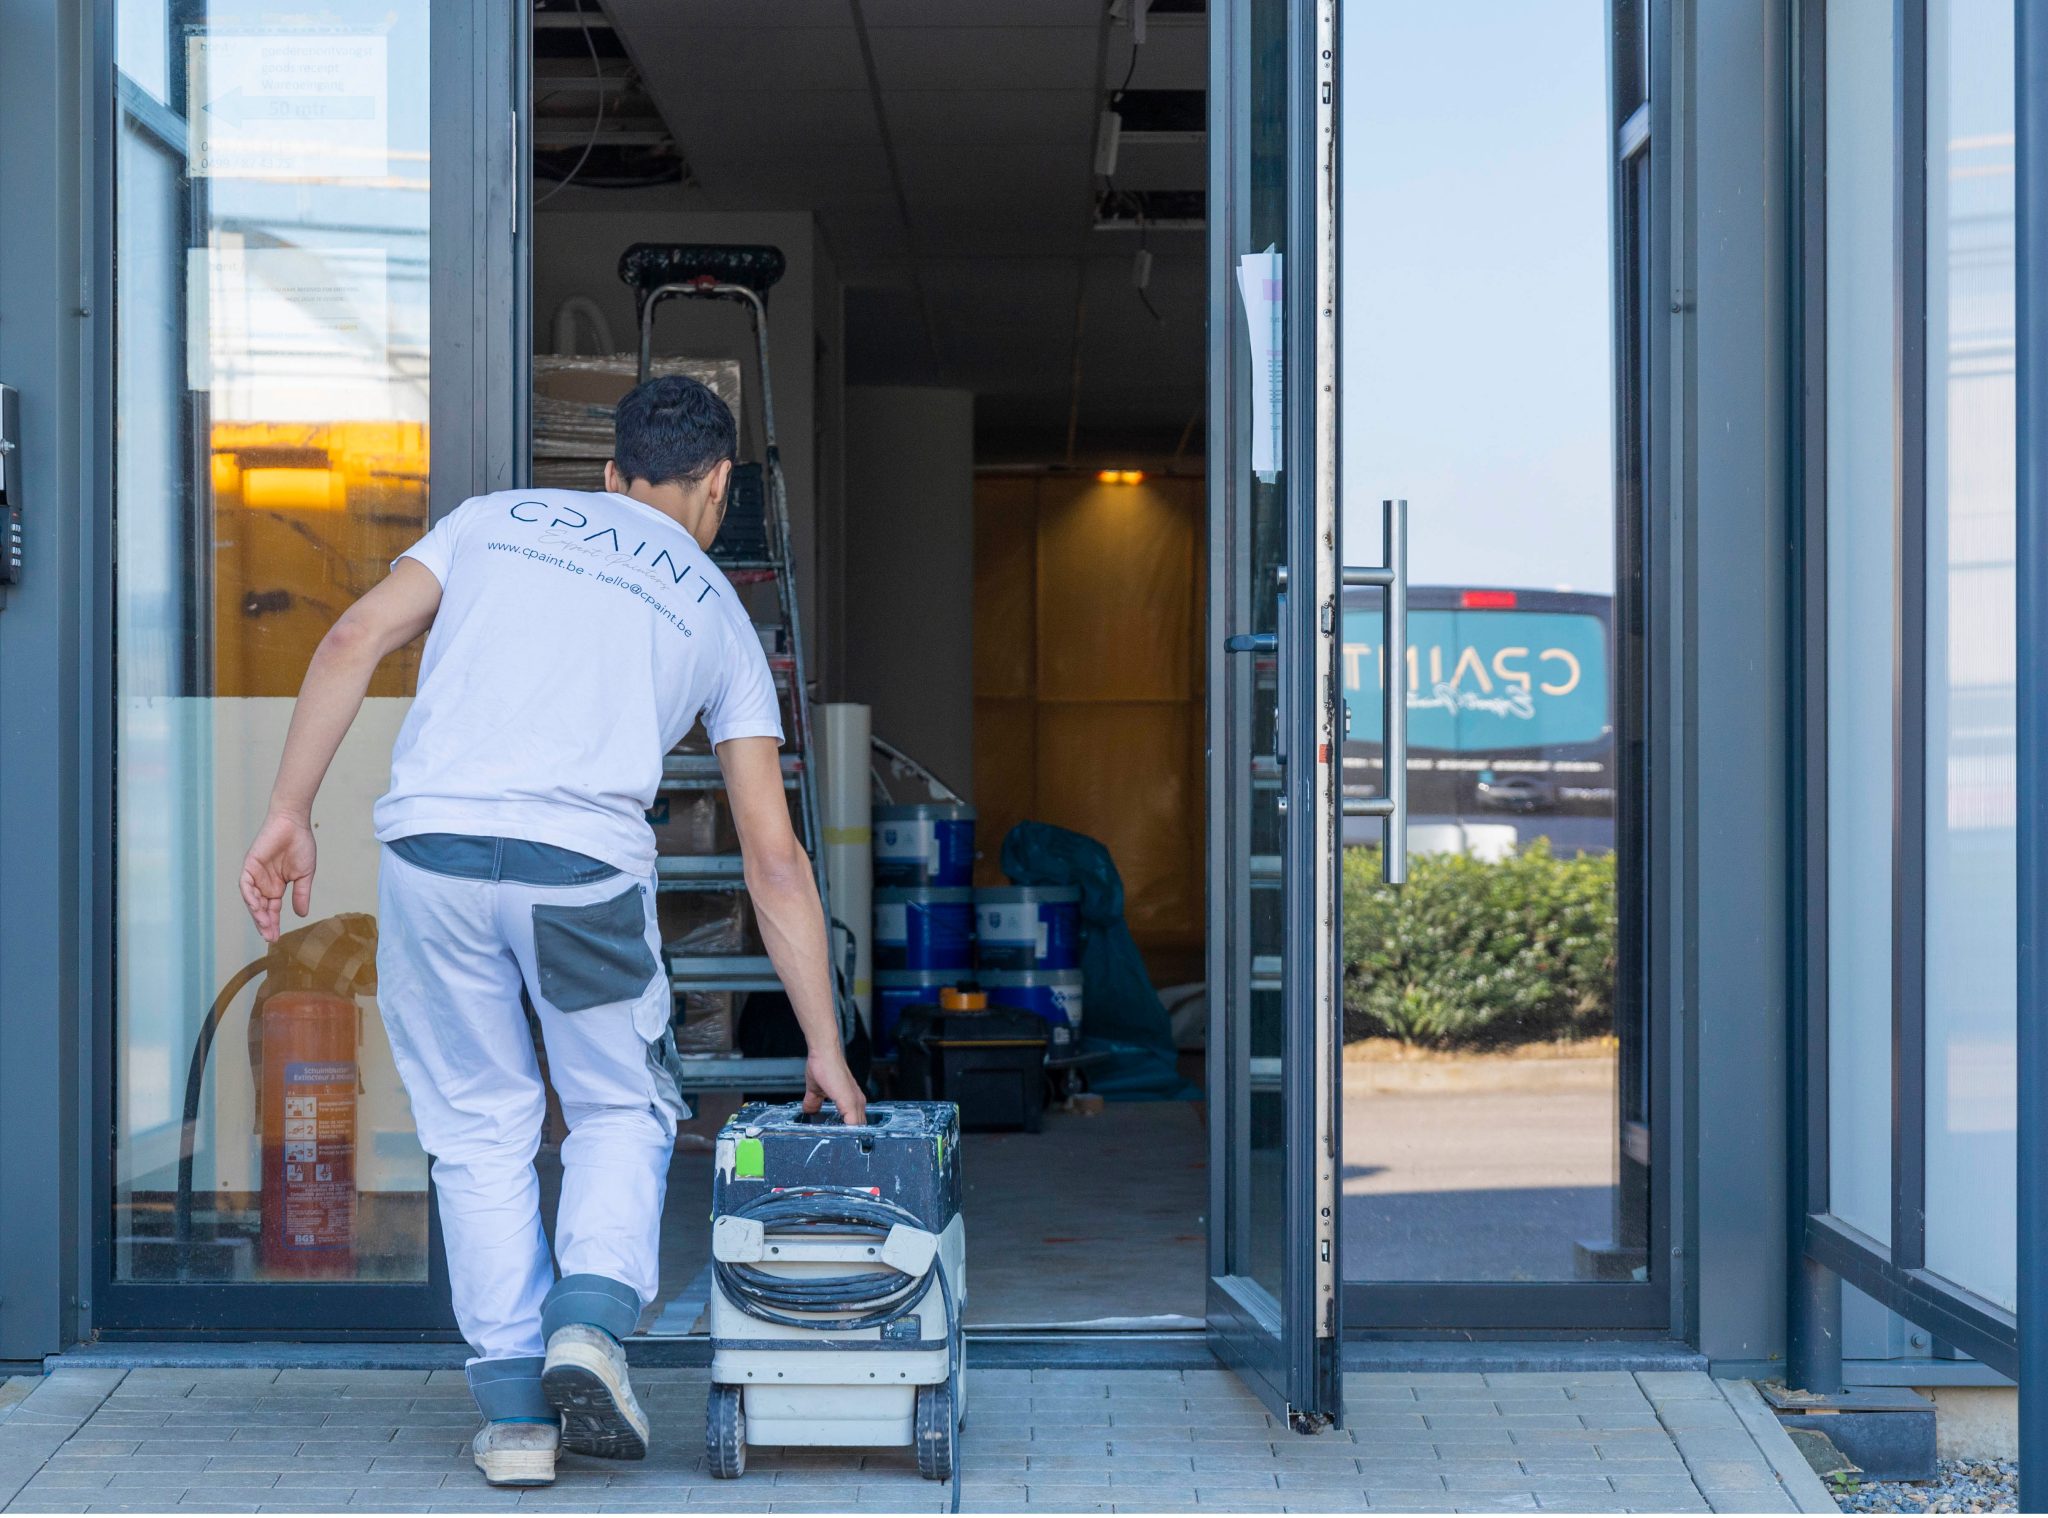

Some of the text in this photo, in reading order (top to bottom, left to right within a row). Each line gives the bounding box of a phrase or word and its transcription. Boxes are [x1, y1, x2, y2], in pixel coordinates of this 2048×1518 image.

[261, 62, 340, 75] goods receipt
[268, 101, 328, 117] 50 mtr
[510, 501, 721, 603] CPAINT
[538, 528, 670, 592] Expert Painters
[487, 541, 585, 575] www.cpaint.be
[596, 572, 693, 638] hello@cpaint.be
[306, 1103, 313, 1112] 1
[306, 1125, 314, 1135] 2
[306, 1148, 314, 1158] 3
[295, 1234, 315, 1243] BGS
